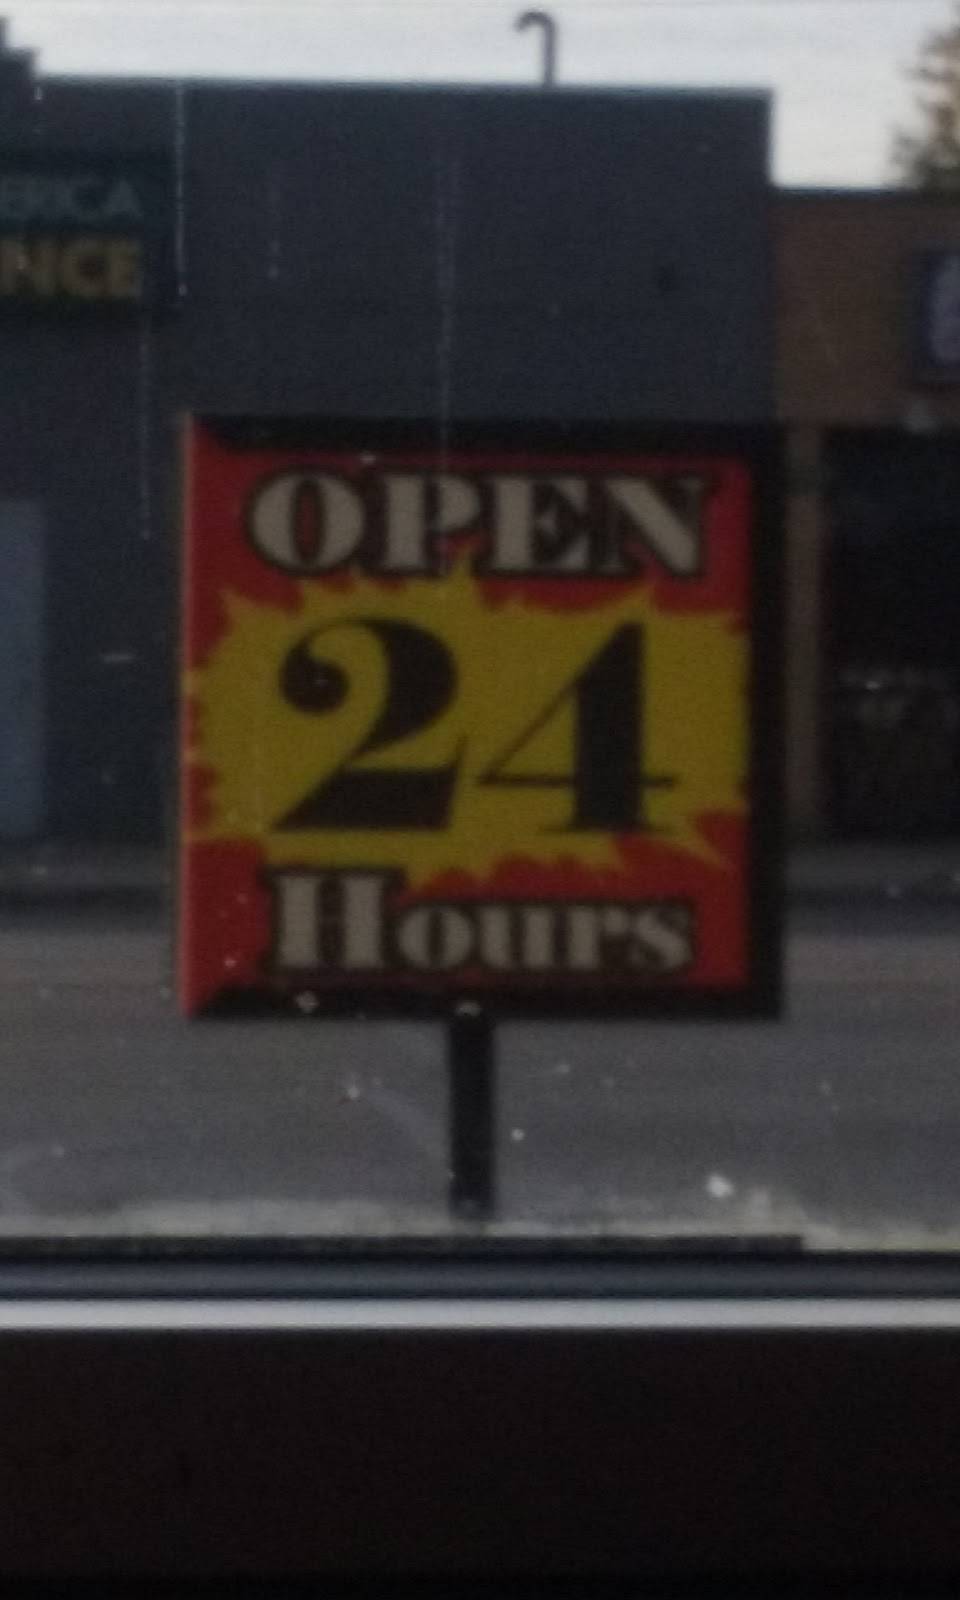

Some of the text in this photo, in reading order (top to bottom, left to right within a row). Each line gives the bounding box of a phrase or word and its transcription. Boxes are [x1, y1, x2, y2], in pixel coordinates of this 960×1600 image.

[248, 470, 707, 577] OPEN
[272, 617, 679, 832] 24
[268, 868, 696, 972] Hours
